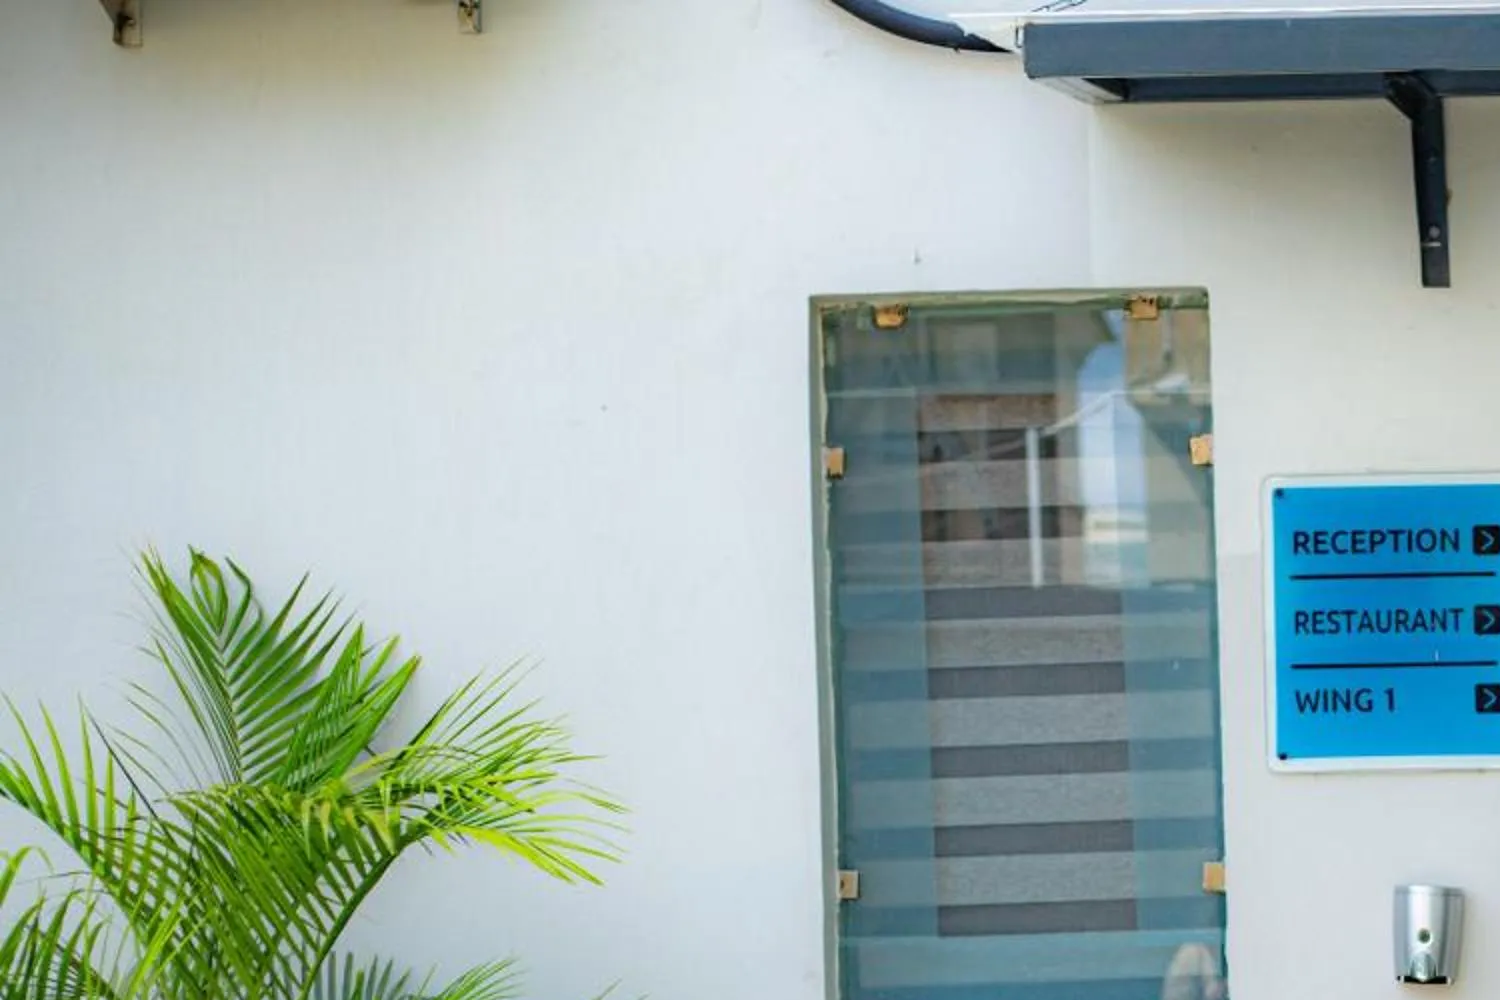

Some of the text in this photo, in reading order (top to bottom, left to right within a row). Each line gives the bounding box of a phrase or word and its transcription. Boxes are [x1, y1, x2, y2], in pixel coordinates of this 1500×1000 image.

[1293, 528, 1460, 555] RECEPTION
[1294, 608, 1464, 635] RESTAURANT
[1294, 687, 1397, 714] WING 1
